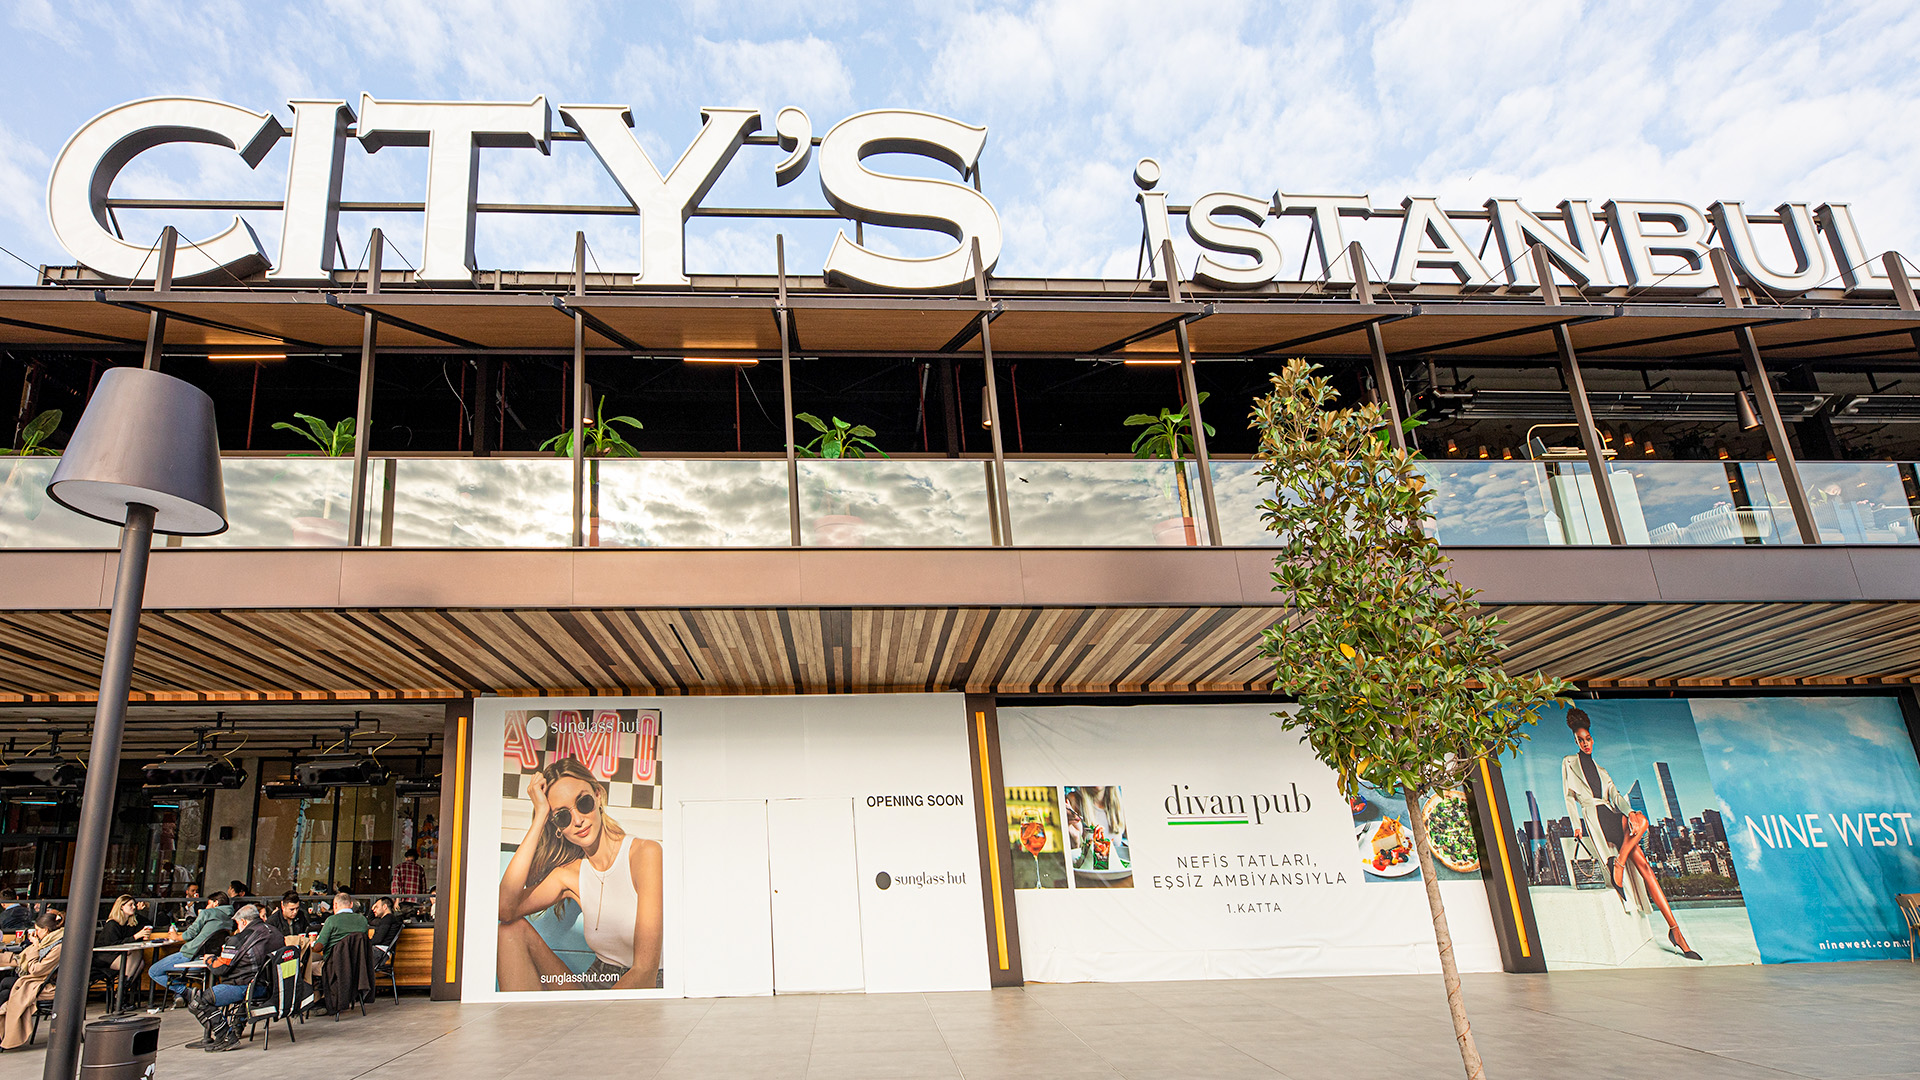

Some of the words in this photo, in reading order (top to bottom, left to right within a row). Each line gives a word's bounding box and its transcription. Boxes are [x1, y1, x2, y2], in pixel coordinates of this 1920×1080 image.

[550, 717, 614, 738] sunglass
[616, 717, 641, 733] hut
[866, 795, 924, 807] OPENING
[927, 794, 964, 806] SOON
[1164, 784, 1248, 816] divan
[1250, 782, 1312, 825] pub
[1745, 813, 1828, 849] NINE
[1828, 812, 1913, 847] WEST
[1177, 853, 1230, 869] NEFİS
[1237, 853, 1317, 867] TATLARI,
[894, 871, 945, 889] sunglass
[946, 870, 967, 885] hut
[1153, 872, 1204, 890] EŞSİZ
[1212, 871, 1347, 888] AMBİYANSIYLA
[1226, 902, 1282, 914] 1.KATTA
[540, 972, 620, 986] sunglasshut.com
